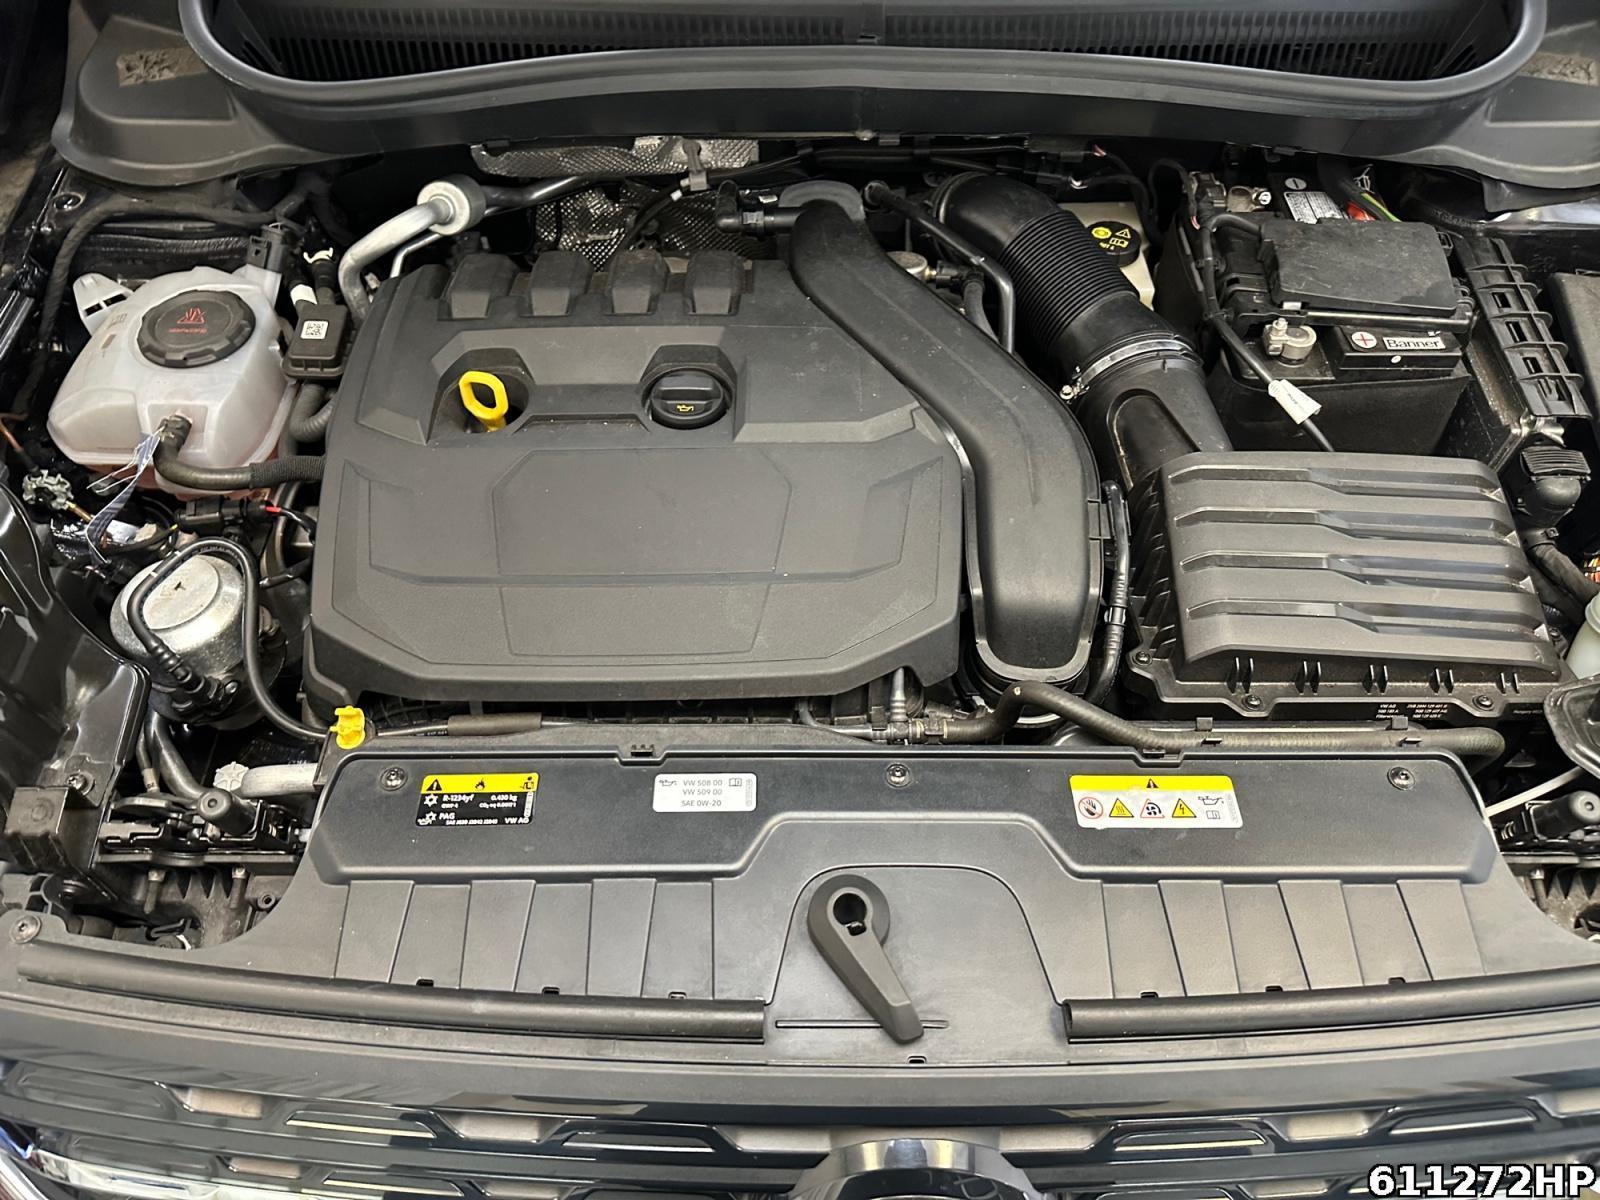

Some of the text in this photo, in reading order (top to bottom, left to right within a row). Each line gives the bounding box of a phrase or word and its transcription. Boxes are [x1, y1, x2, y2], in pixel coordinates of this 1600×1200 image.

[1386, 339, 1440, 348] Banner
[442, 794, 475, 803] R-1234yf
[509, 793, 518, 802] kg
[696, 799, 722, 807] 0W-20
[439, 812, 456, 820] PAG
